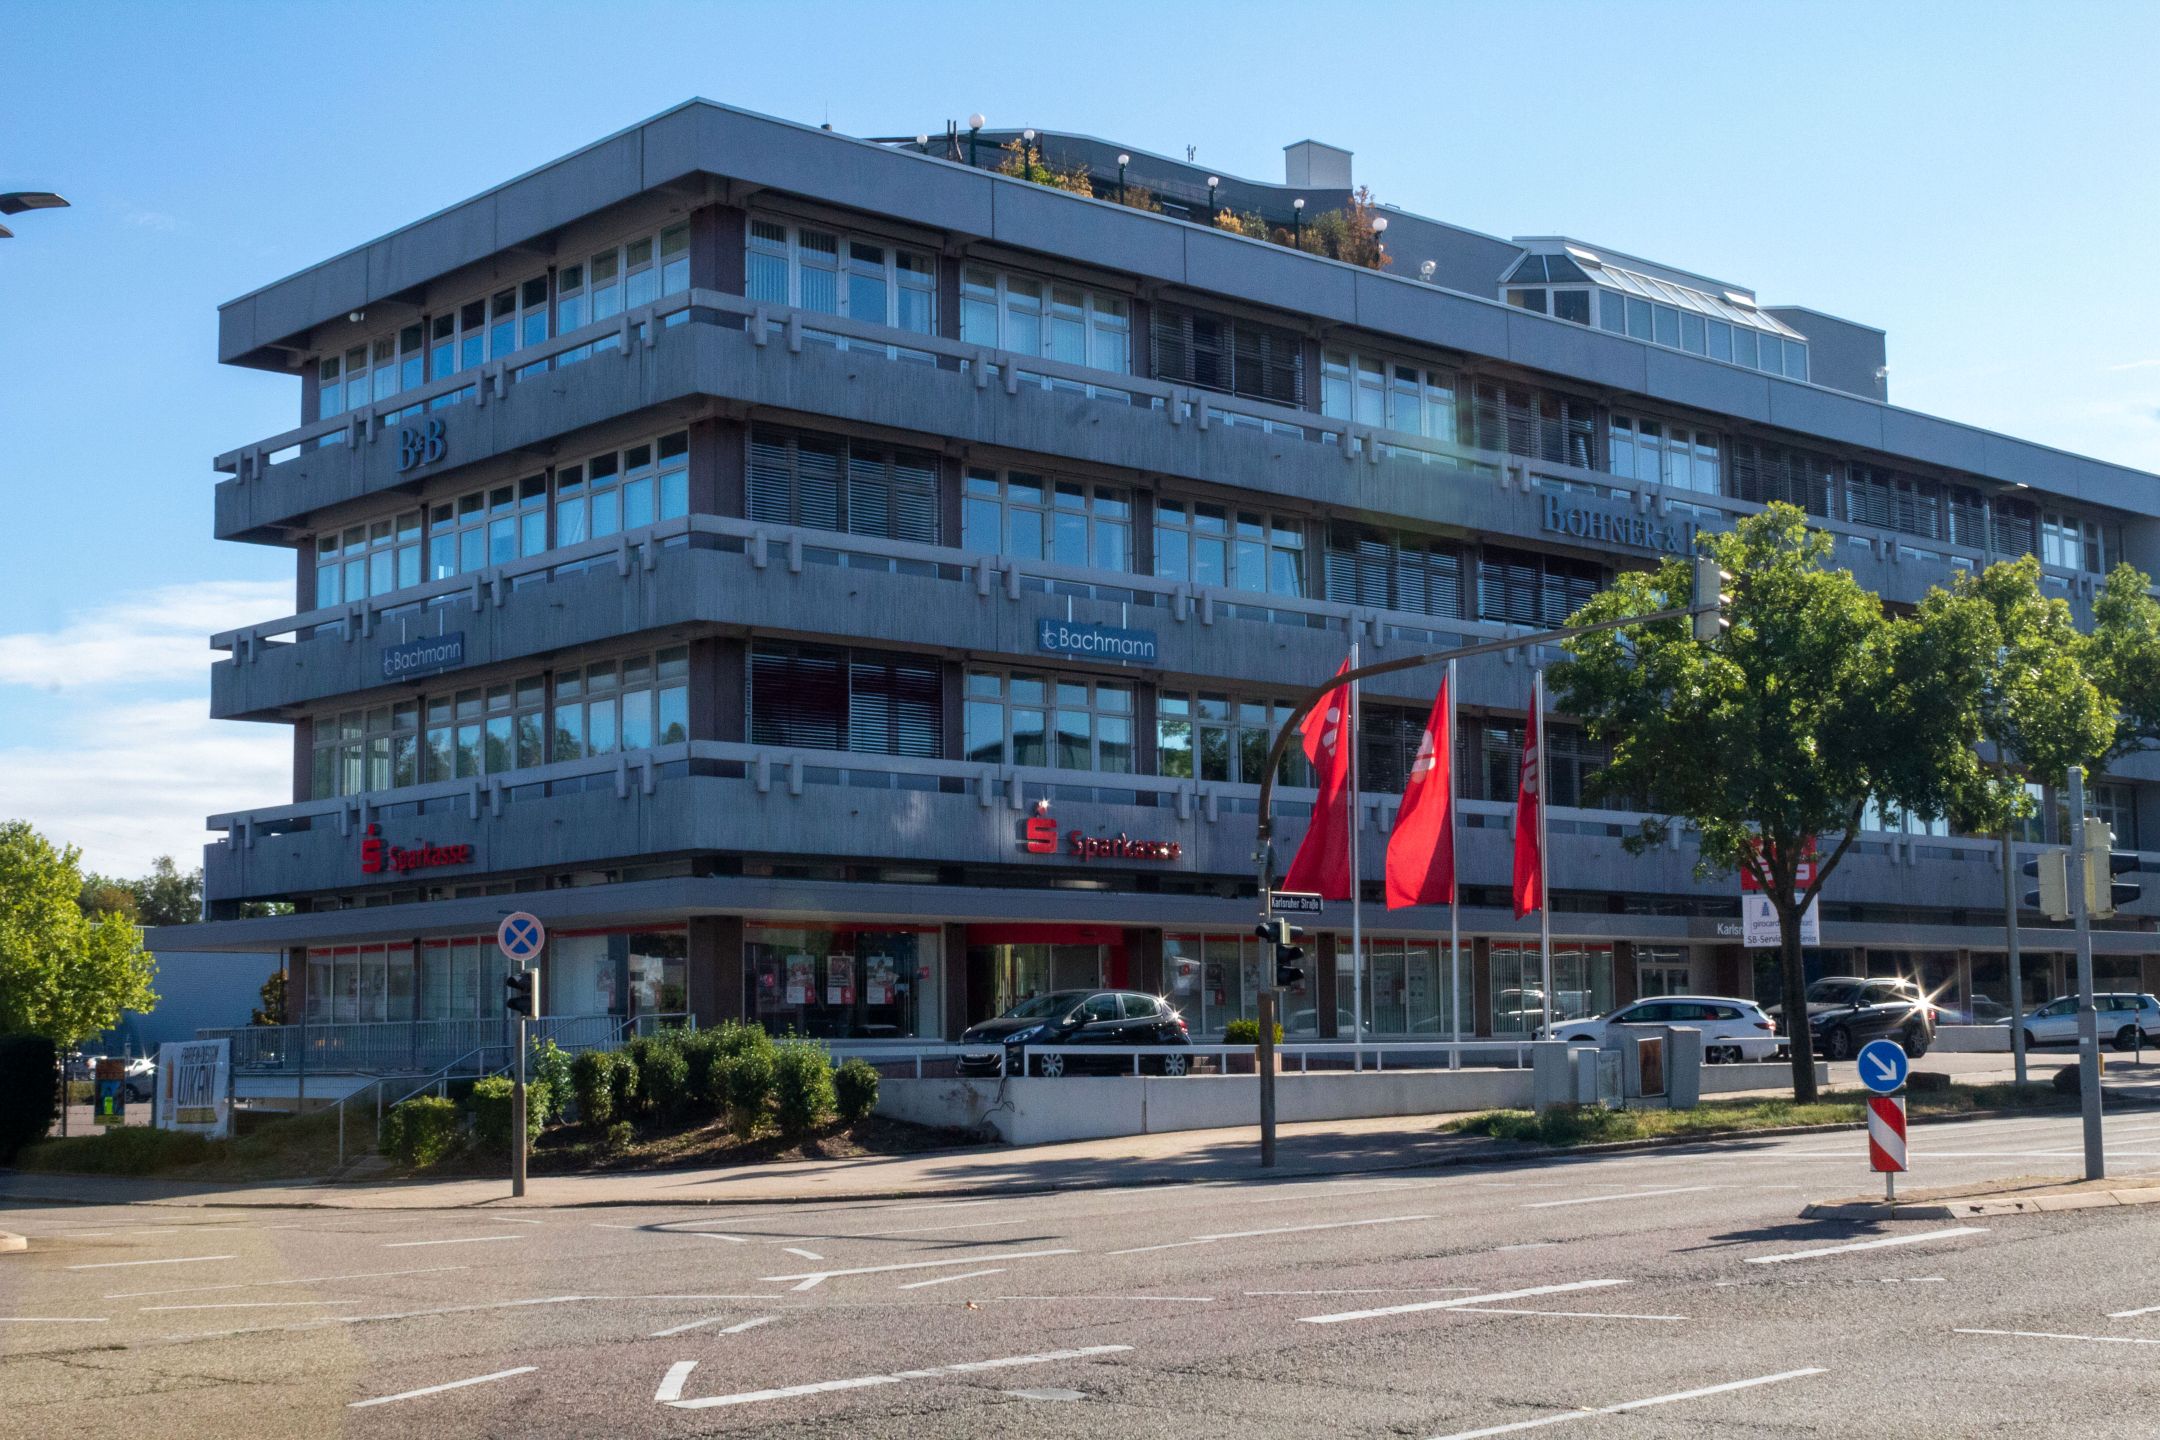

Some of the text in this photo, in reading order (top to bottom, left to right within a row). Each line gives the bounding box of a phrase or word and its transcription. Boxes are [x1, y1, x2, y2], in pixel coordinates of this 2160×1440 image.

[394, 642, 461, 671] Bachmann
[1060, 627, 1154, 657] Bachmann
[390, 841, 470, 873] Sparkasse
[1071, 831, 1181, 862] Sparkasse
[1271, 897, 1319, 910] Karlsruher Straße
